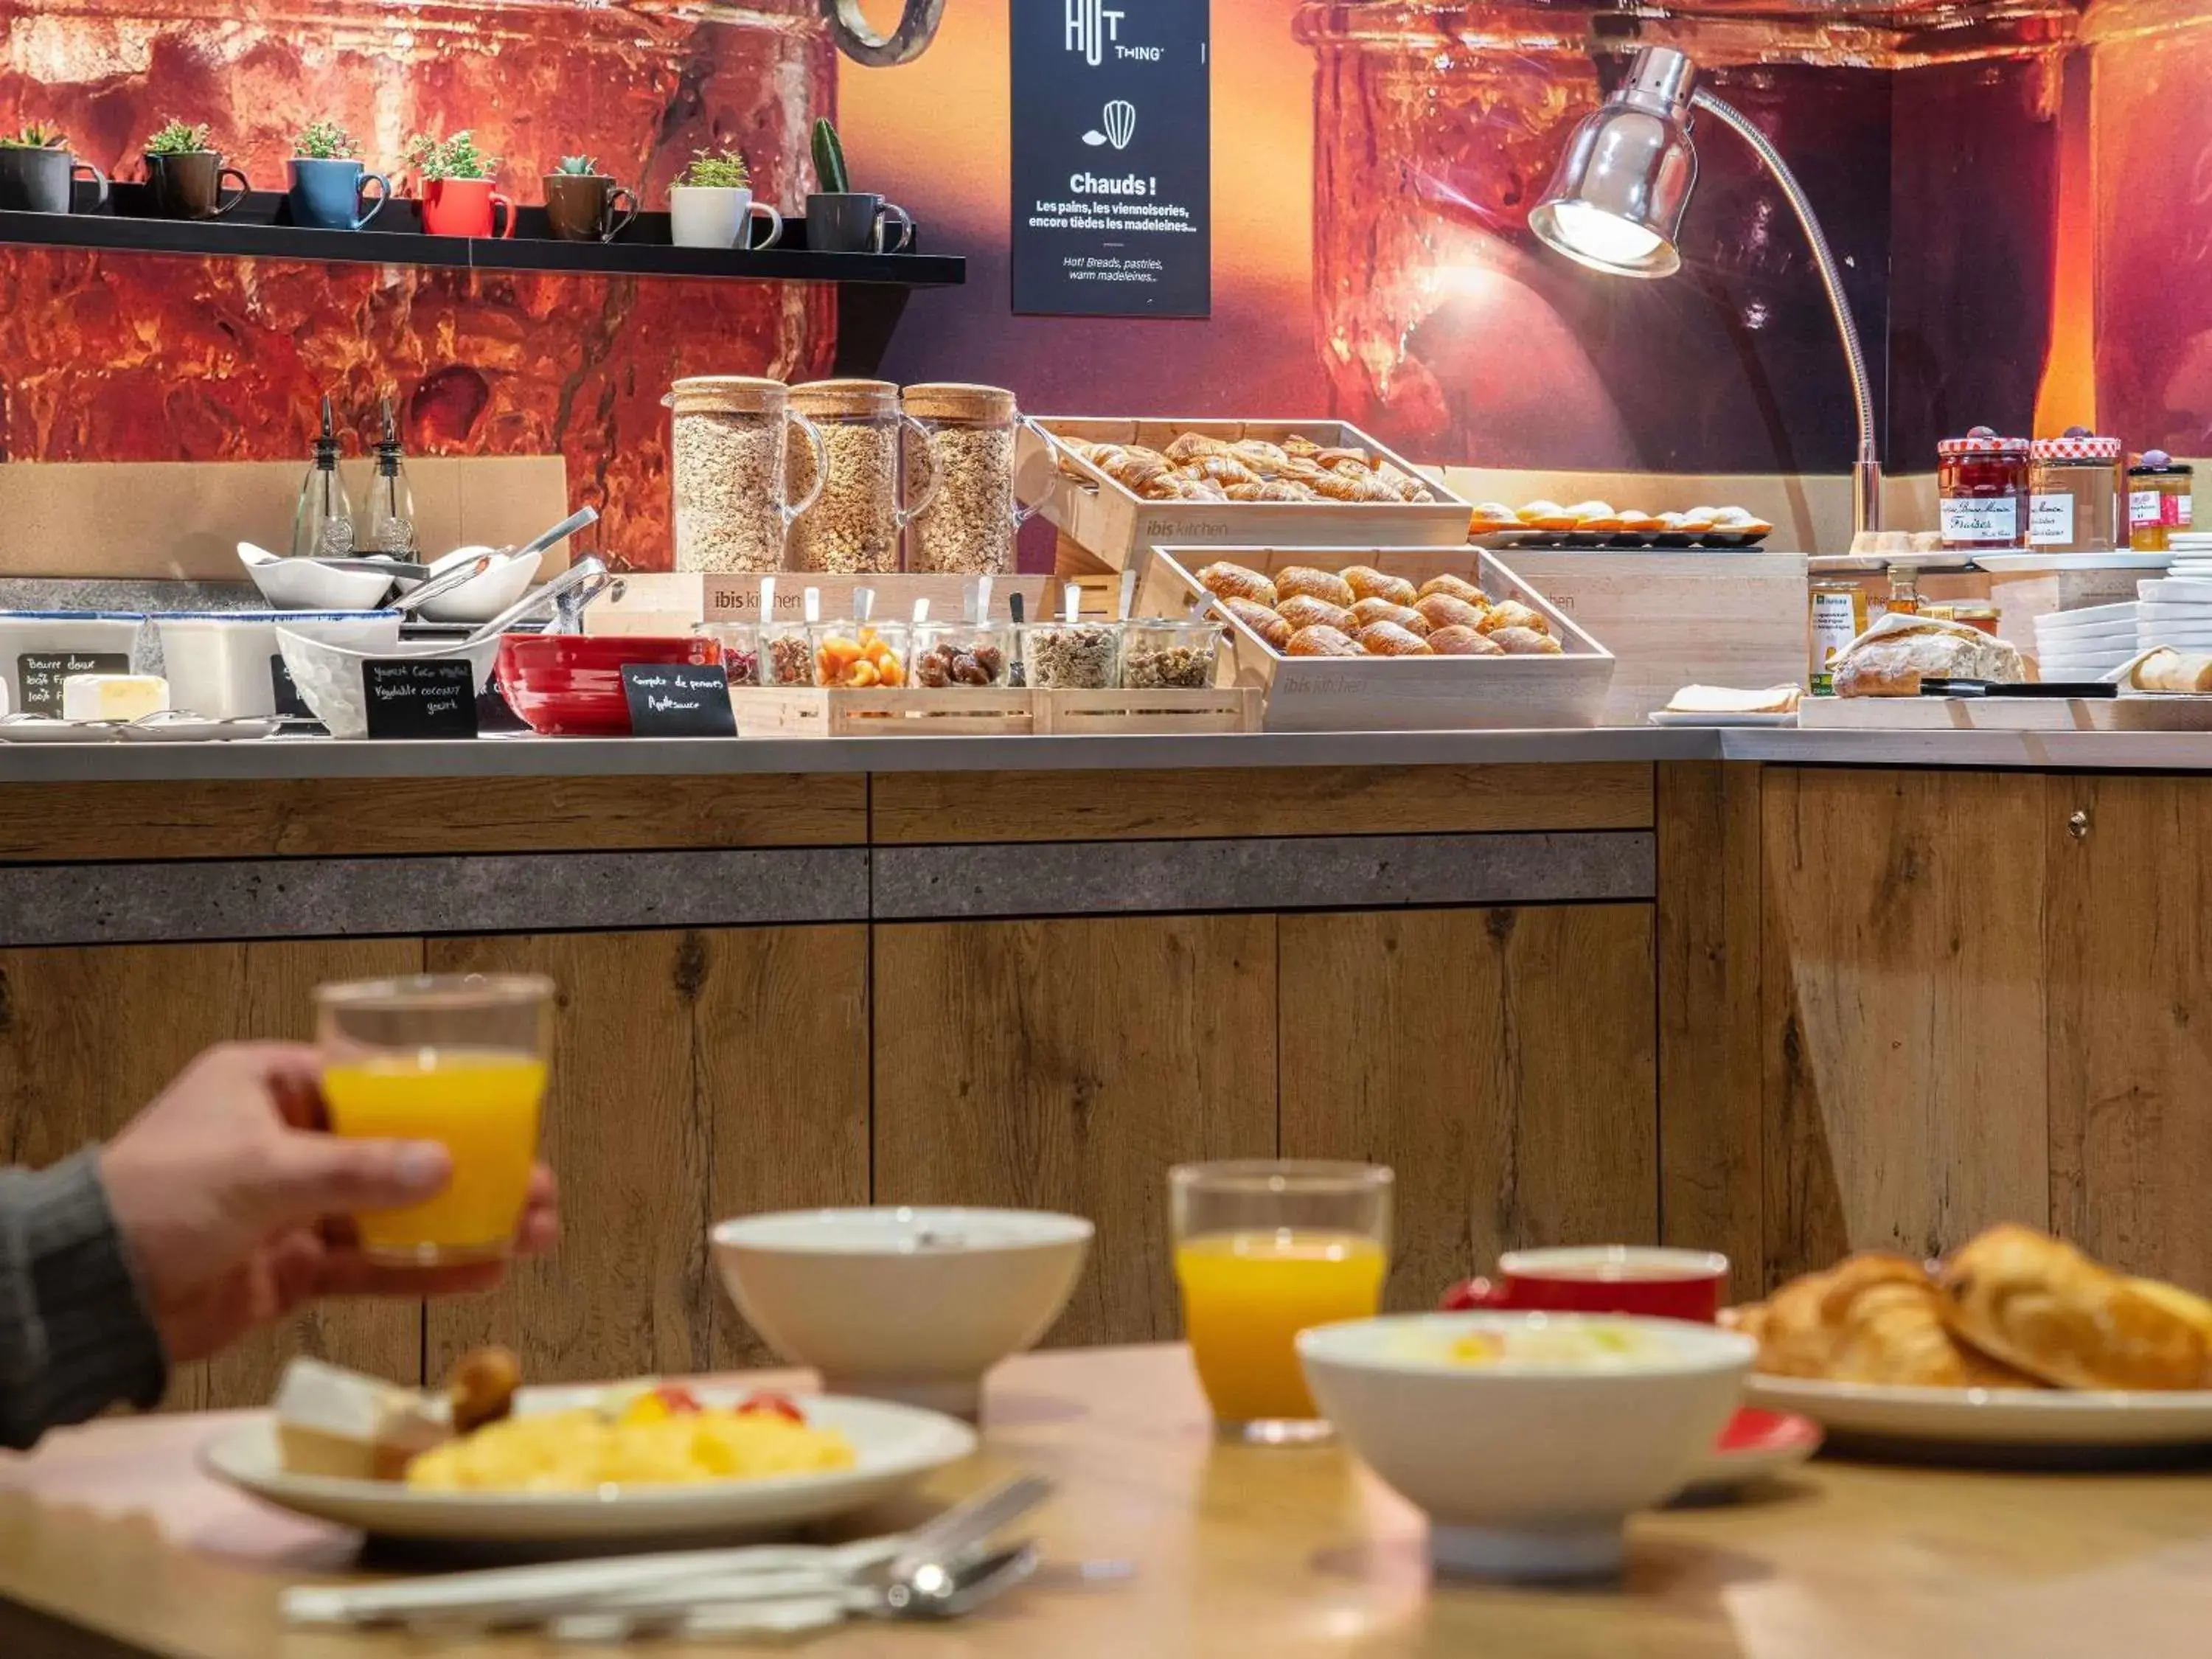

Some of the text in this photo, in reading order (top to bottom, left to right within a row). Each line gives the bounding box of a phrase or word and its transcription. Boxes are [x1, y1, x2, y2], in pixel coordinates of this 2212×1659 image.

[1070, 172, 1146, 195] Chauds
[1036, 200, 1189, 218] Les pains, les viennoiseries,
[1029, 216, 1197, 232] encore tièdes les madeleines...
[1063, 257, 1085, 267] Hot!
[1069, 271, 1096, 280] warm
[1147, 520, 1228, 538] ibis kitchen
[714, 591, 801, 608] ibis kihen
[67, 655, 96, 670] doux
[1284, 676, 1310, 694] ibis
